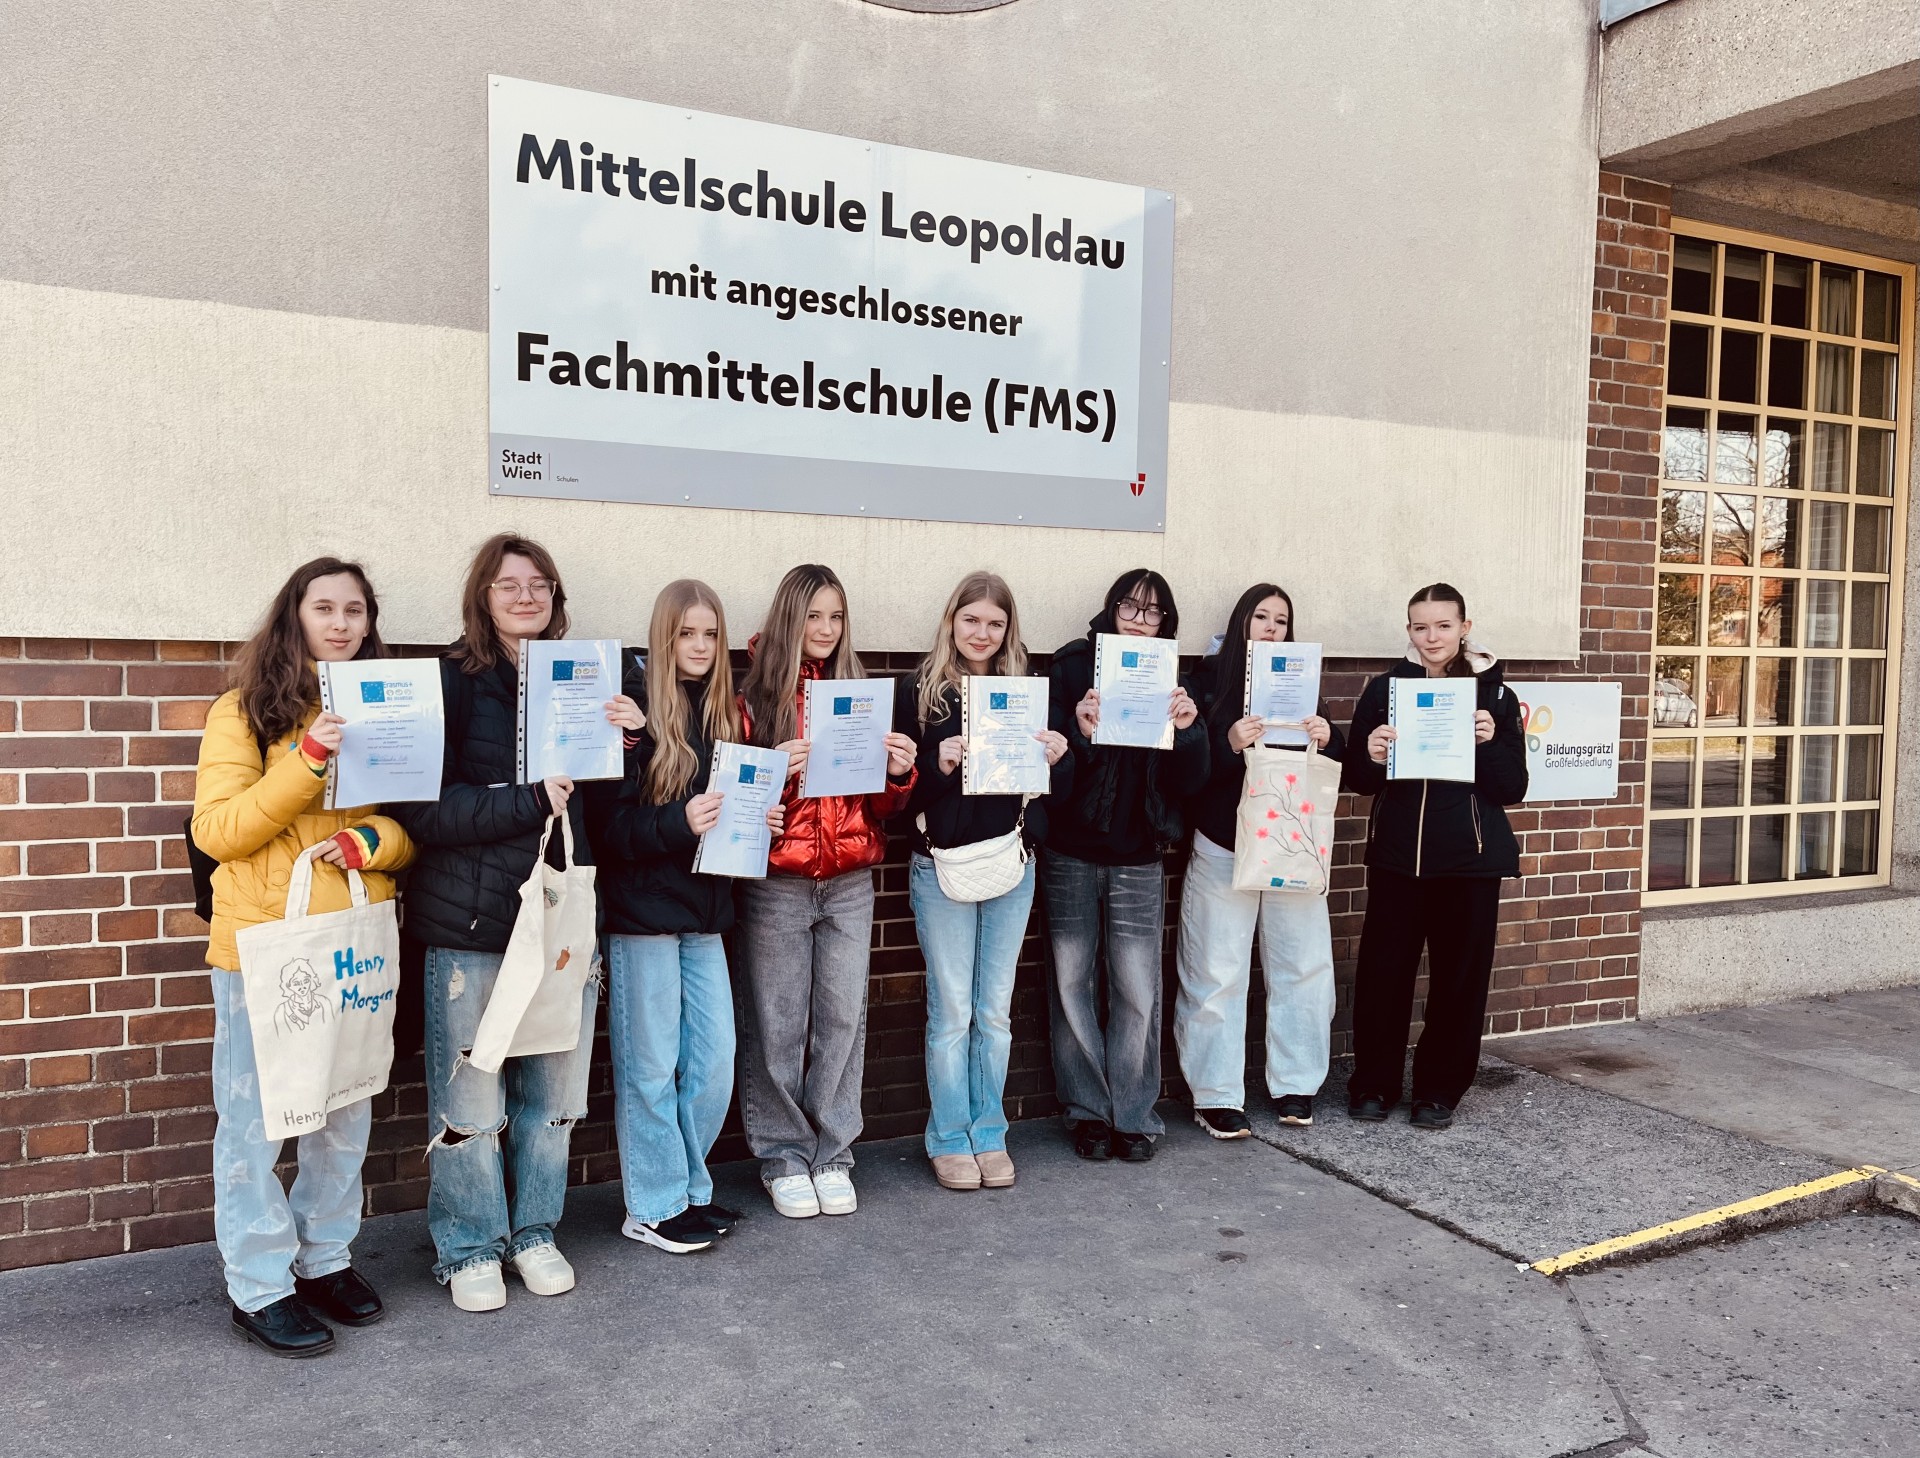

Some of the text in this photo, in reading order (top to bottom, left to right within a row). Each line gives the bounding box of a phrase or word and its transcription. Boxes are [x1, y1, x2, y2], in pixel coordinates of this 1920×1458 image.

[516, 133, 1125, 270] Mittelschule Leopoldau
[651, 263, 1023, 337] mit angeschlossener
[517, 331, 1117, 443] Fachmittelschule (FMS)
[502, 449, 542, 465] Stadt
[502, 465, 542, 480] Wien
[556, 475, 580, 483] Schulen
[1546, 742, 1614, 758] Bildungsgrätzl
[1545, 757, 1613, 769] Großfeldsiedlung
[333, 947, 385, 980] Henry
[341, 984, 394, 1013] Morgan
[283, 1109, 324, 1126] Henry
